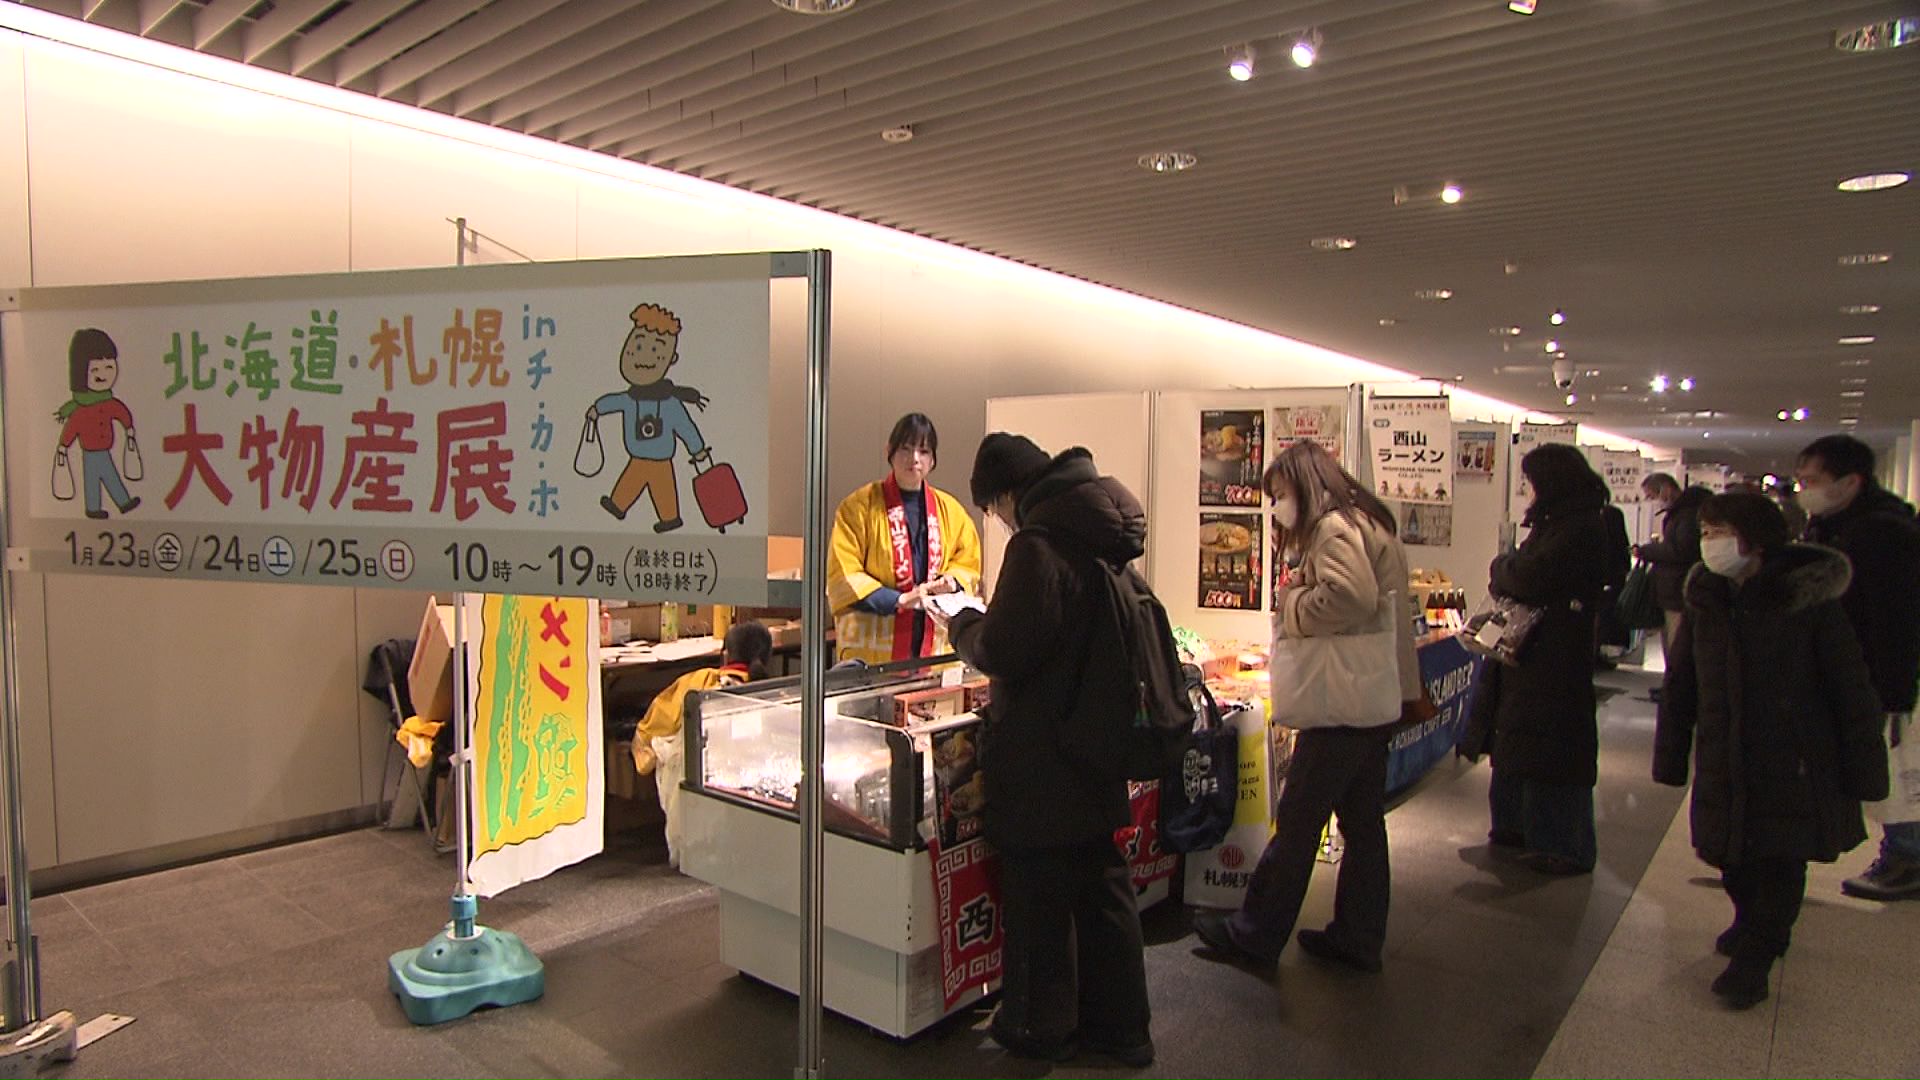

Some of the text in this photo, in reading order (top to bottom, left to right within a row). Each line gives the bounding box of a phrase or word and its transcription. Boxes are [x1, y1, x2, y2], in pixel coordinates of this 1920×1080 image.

[162, 308, 511, 401] 北海道・札幌
[162, 397, 517, 522] 大物産展
[1378, 448, 1445, 464] ラーメン
[1393, 430, 1427, 447] 西山
[956, 895, 997, 949] 西
